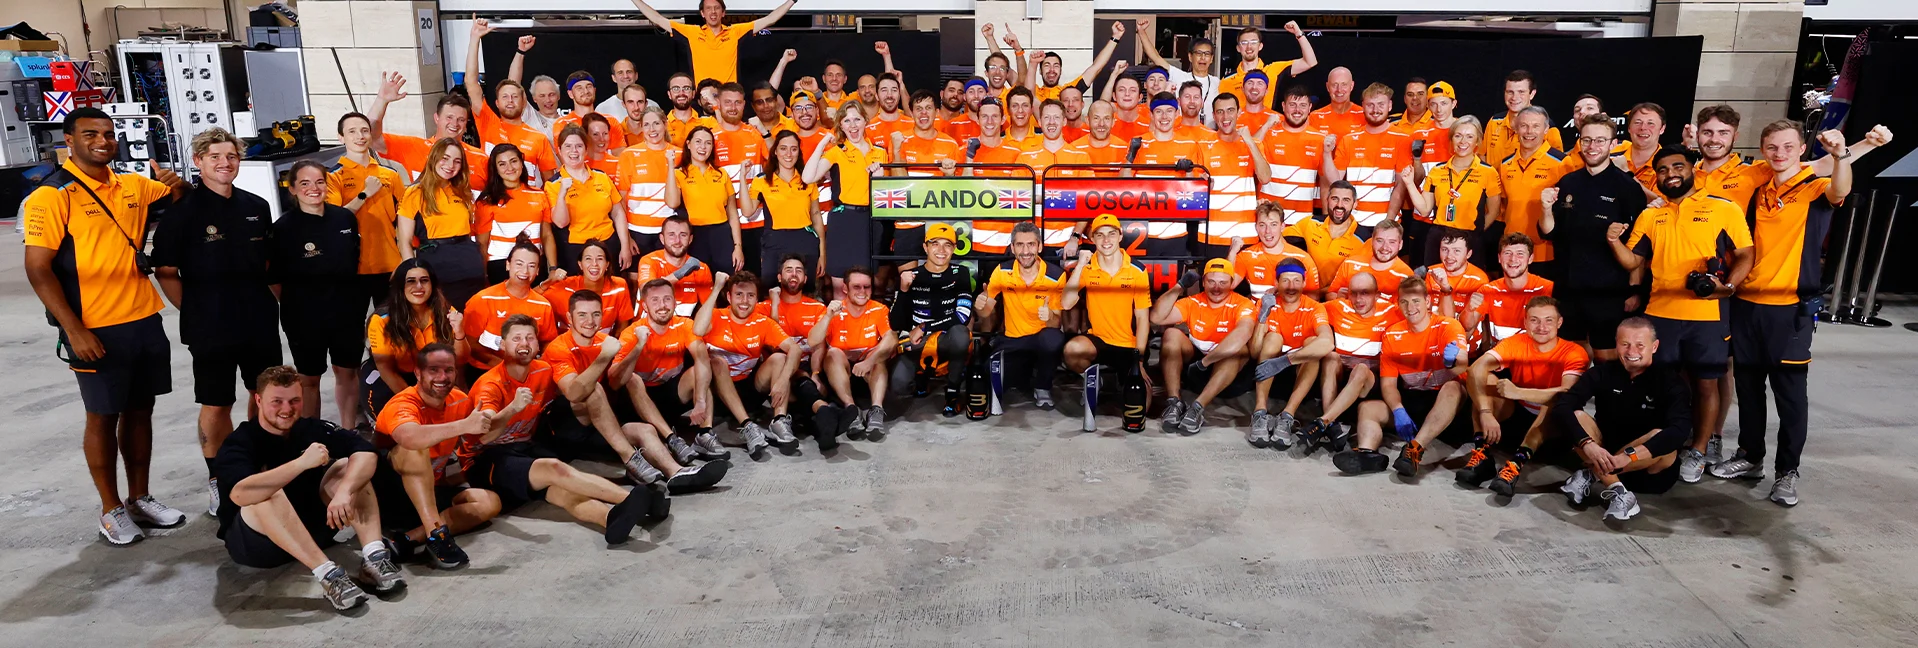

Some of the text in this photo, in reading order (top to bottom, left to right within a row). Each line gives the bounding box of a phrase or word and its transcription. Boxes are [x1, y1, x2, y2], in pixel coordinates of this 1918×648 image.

[421, 17, 433, 29] 20
[1722, 182, 1739, 190] OKX
[906, 190, 997, 209] LANDO
[1085, 191, 1169, 210] OSCAR
[1127, 223, 1147, 256] 2
[969, 394, 987, 406] 3
